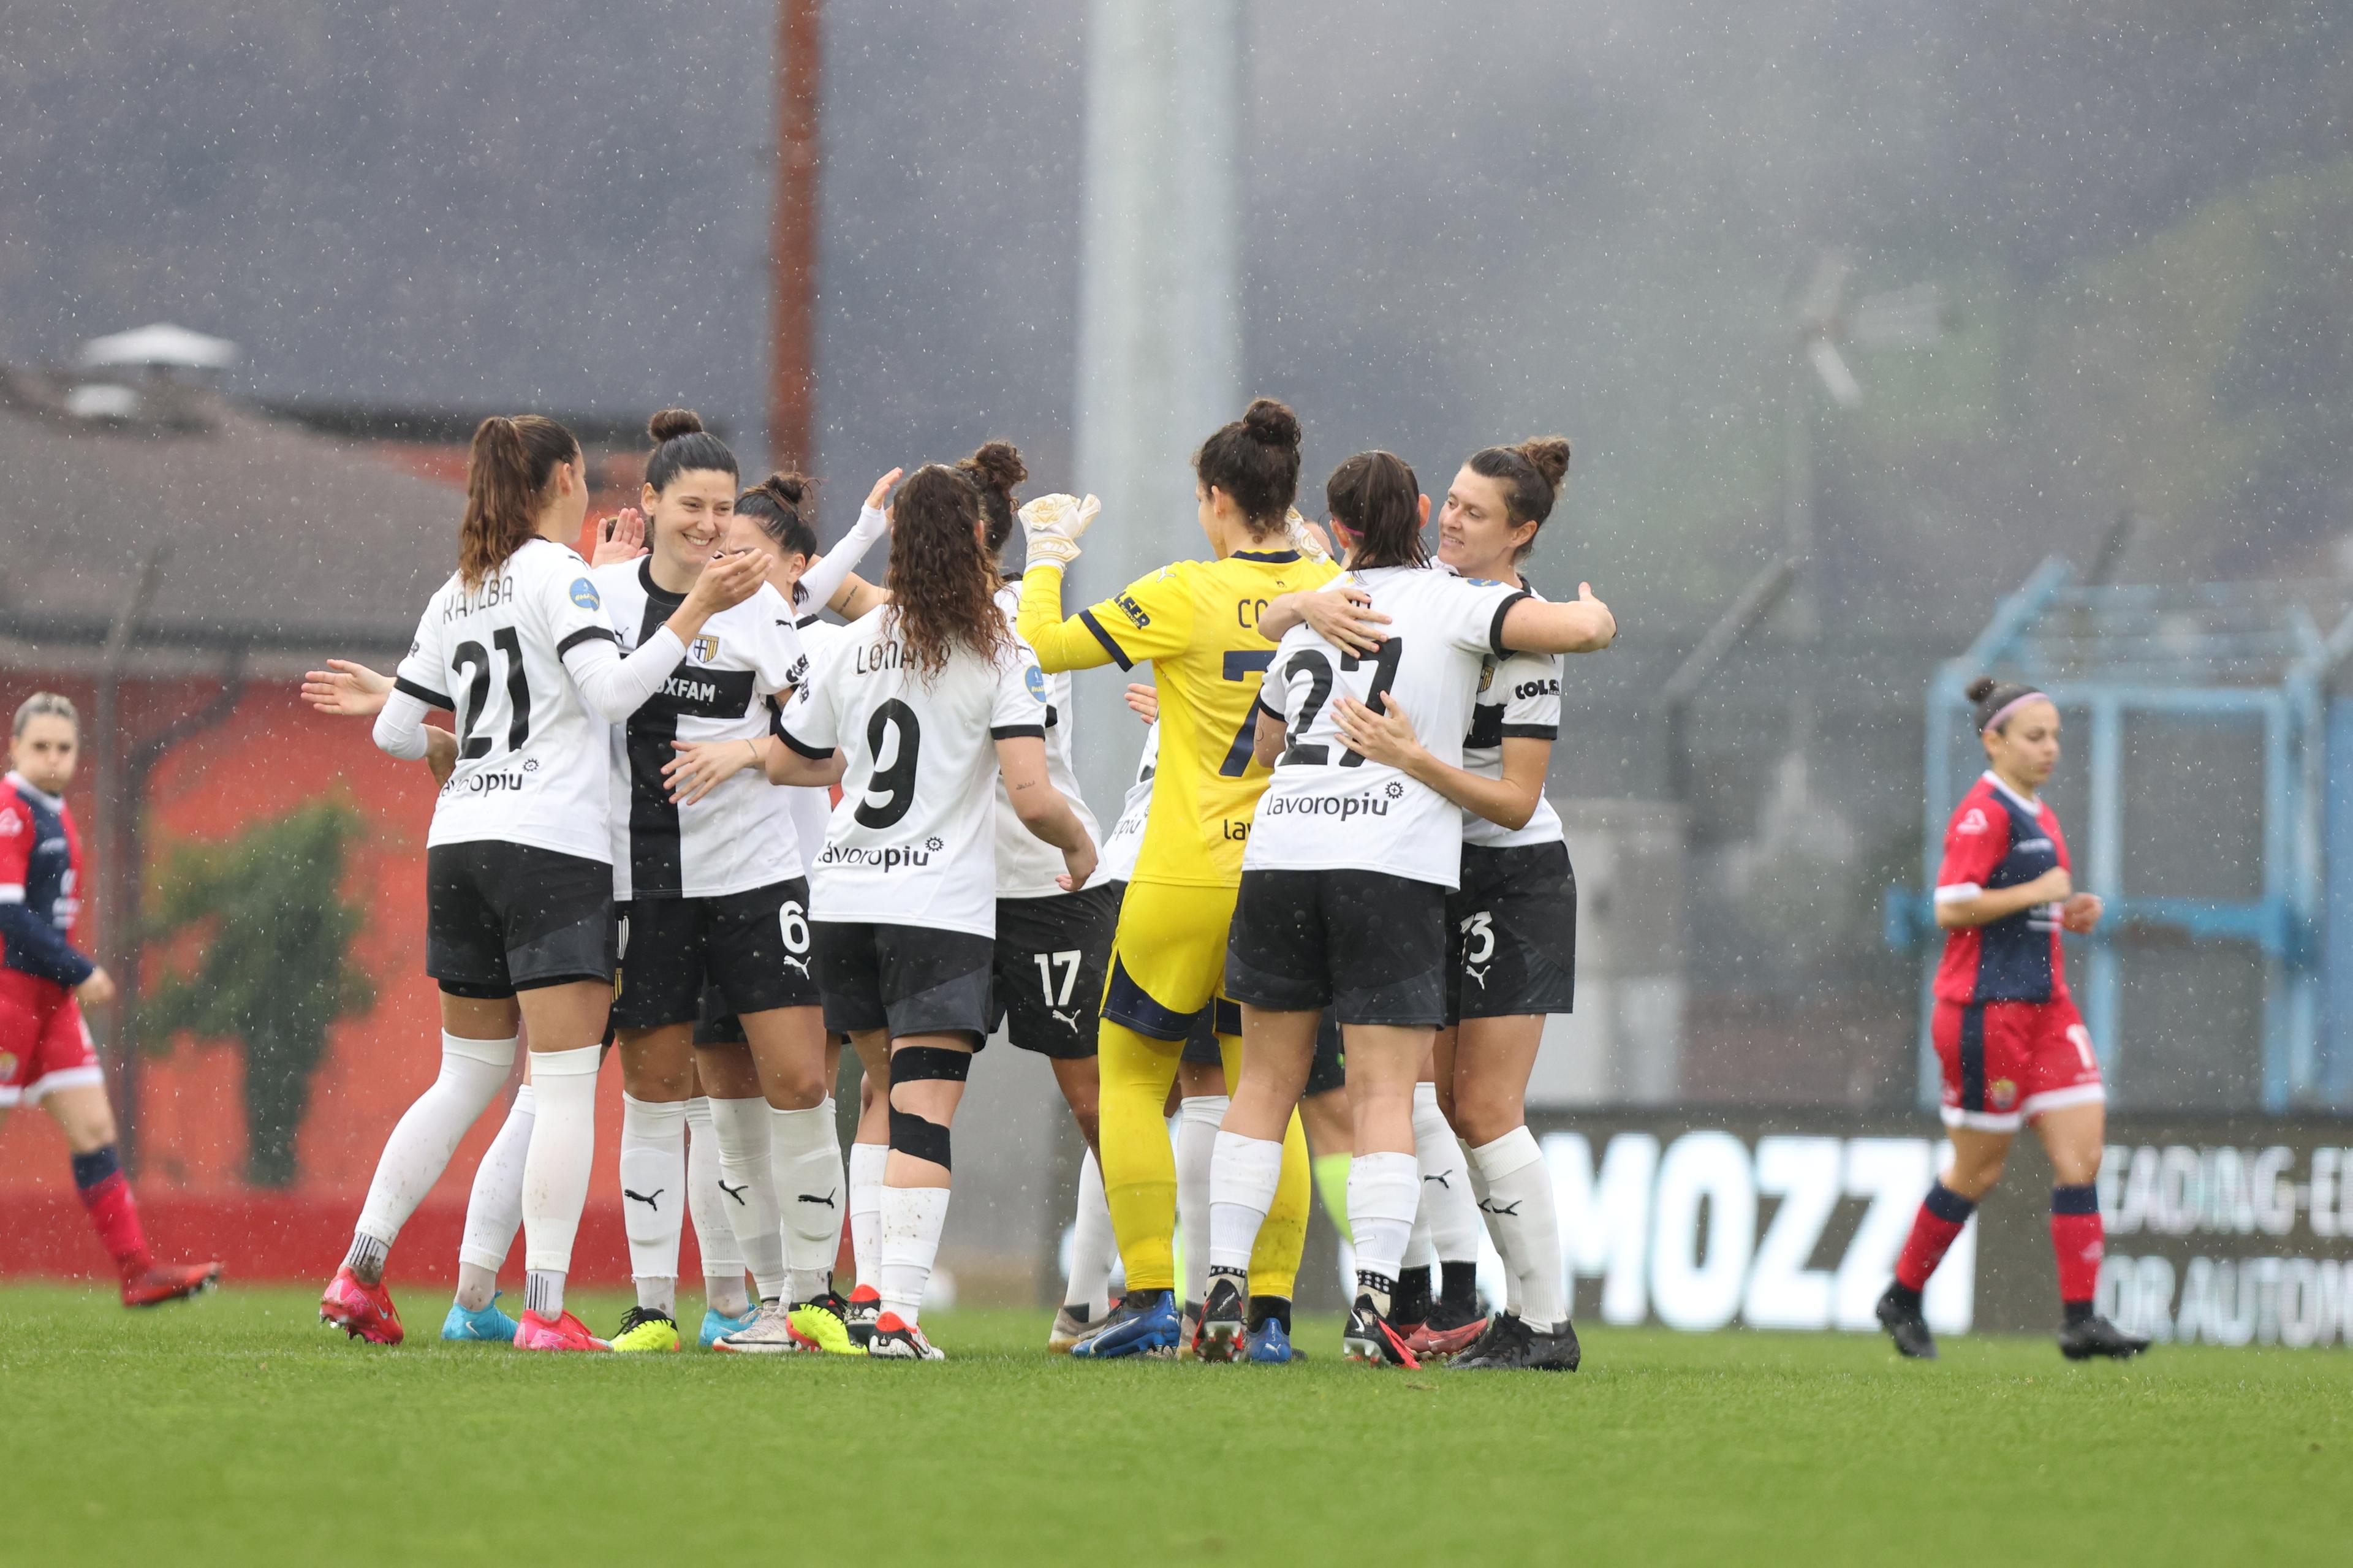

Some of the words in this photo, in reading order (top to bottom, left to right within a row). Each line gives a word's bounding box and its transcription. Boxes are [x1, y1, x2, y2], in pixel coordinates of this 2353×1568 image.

[1114, 591, 1151, 630] LSER
[452, 626, 531, 760] 21
[1278, 637, 1402, 767] 27
[854, 697, 920, 829] 9
[1267, 792, 1388, 821] lavoropiu
[779, 900, 810, 954] 6
[1034, 950, 1082, 1006] 17
